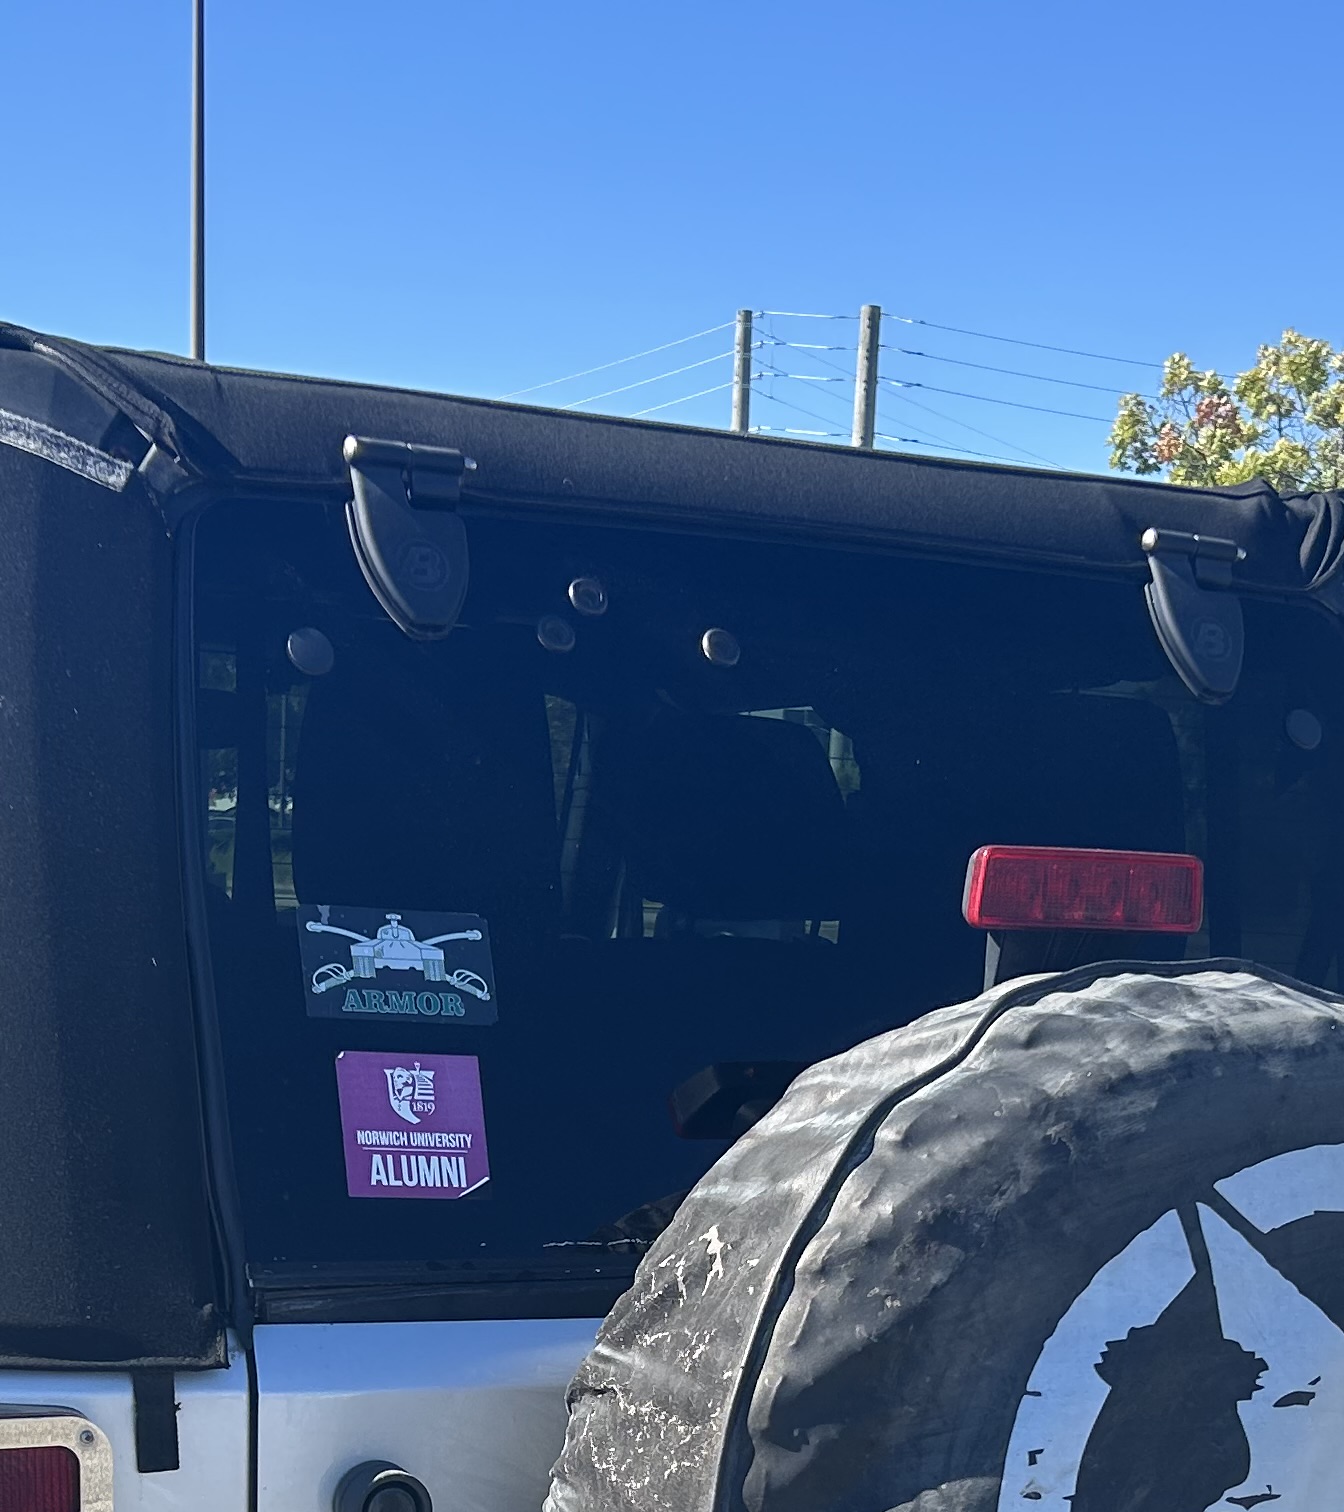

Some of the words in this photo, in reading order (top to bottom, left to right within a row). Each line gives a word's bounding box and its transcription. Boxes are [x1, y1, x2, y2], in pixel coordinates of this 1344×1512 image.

[342, 989, 465, 1016] ARMOR
[412, 1101, 436, 1115] 1819
[356, 1130, 408, 1146] NORWICH
[409, 1131, 473, 1149] UNIVERSITY
[370, 1154, 467, 1188] ALUMNI
